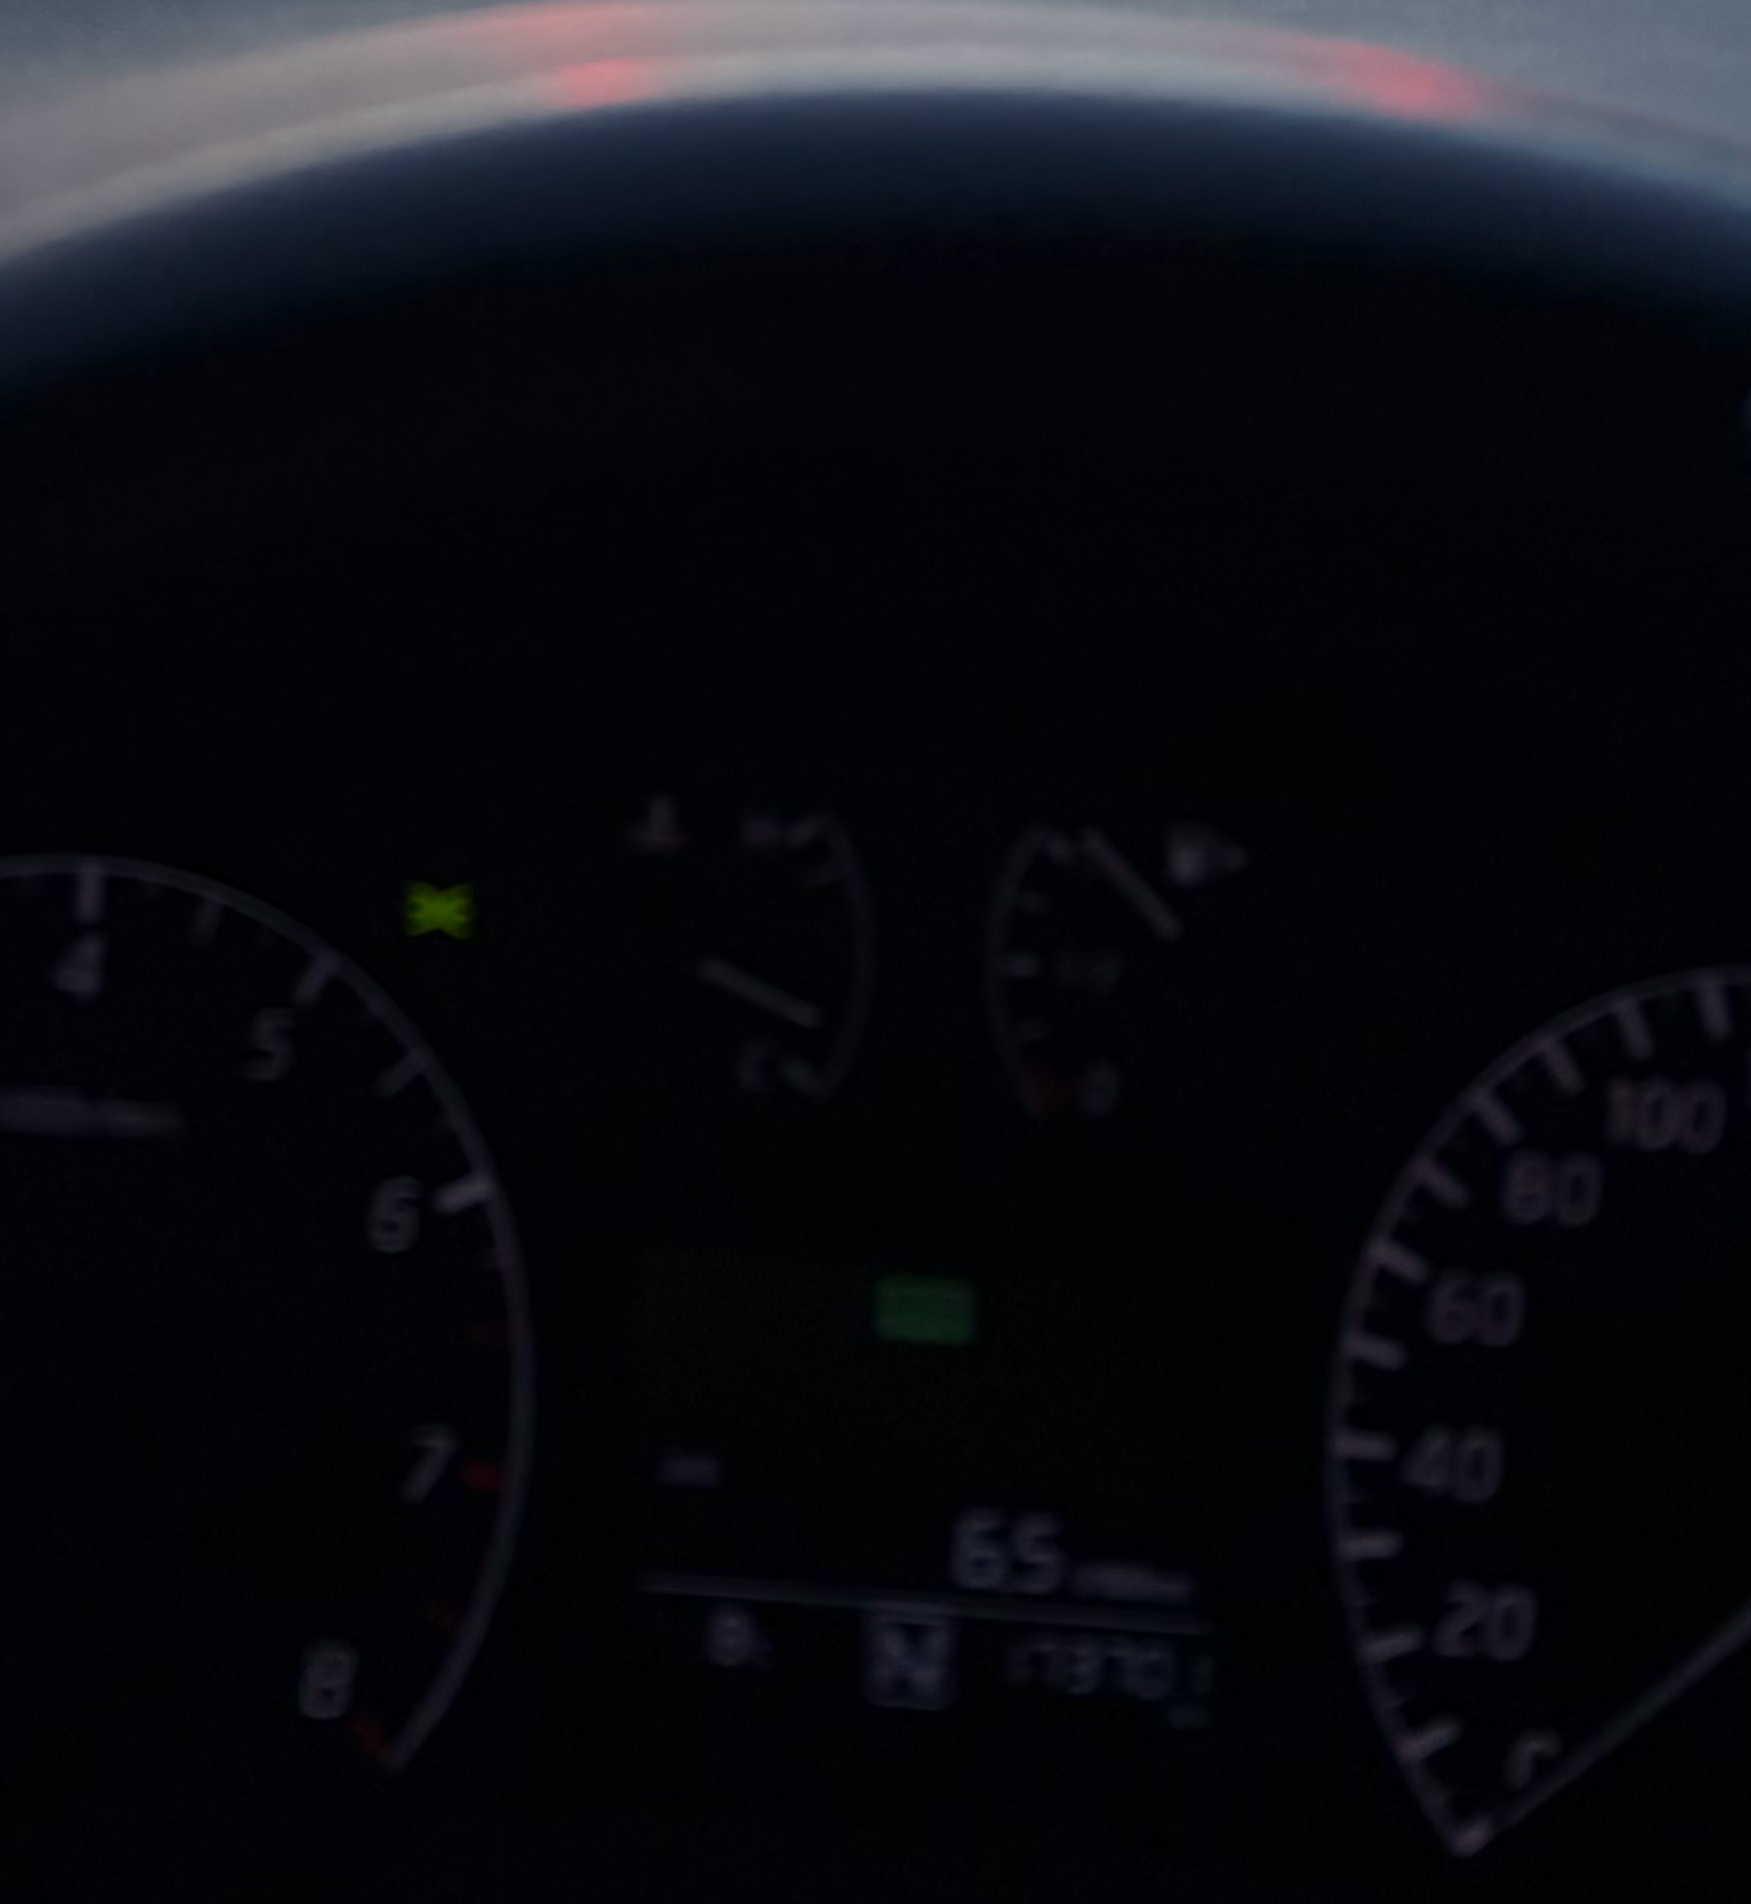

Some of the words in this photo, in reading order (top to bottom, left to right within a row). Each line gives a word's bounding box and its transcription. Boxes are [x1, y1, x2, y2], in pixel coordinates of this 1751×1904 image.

[53, 930, 109, 1006] 4
[236, 1004, 296, 1082] 5
[1605, 1076, 1727, 1154] 100
[365, 1174, 422, 1255] 6
[1500, 1149, 1605, 1228] 80
[1425, 1268, 1527, 1348] 60
[399, 1423, 457, 1503] 7
[1399, 1422, 1506, 1504] 40
[1431, 1580, 1539, 1663] 20
[297, 1639, 360, 1721] 8
